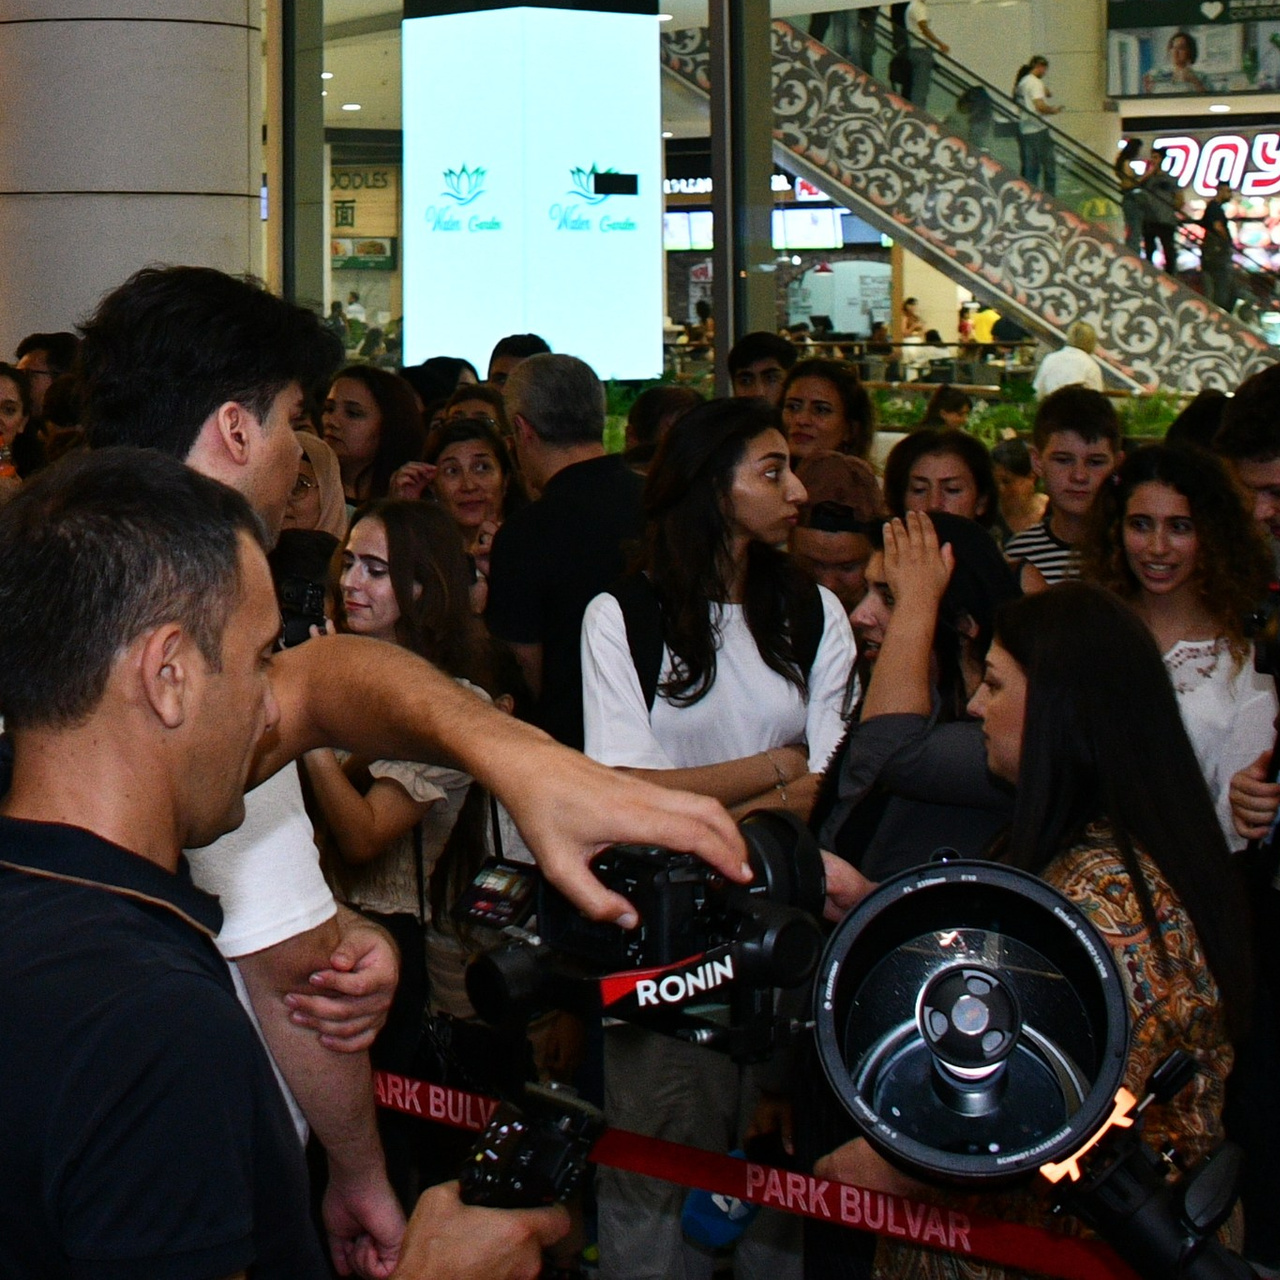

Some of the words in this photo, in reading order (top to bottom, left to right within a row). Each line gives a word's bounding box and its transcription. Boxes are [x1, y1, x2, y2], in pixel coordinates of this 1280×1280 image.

[636, 954, 734, 1007] RONIN
[375, 1071, 422, 1114] ARK
[429, 1084, 501, 1129] BULV
[746, 1163, 831, 1218] PARK
[840, 1183, 972, 1252] BULVAR
